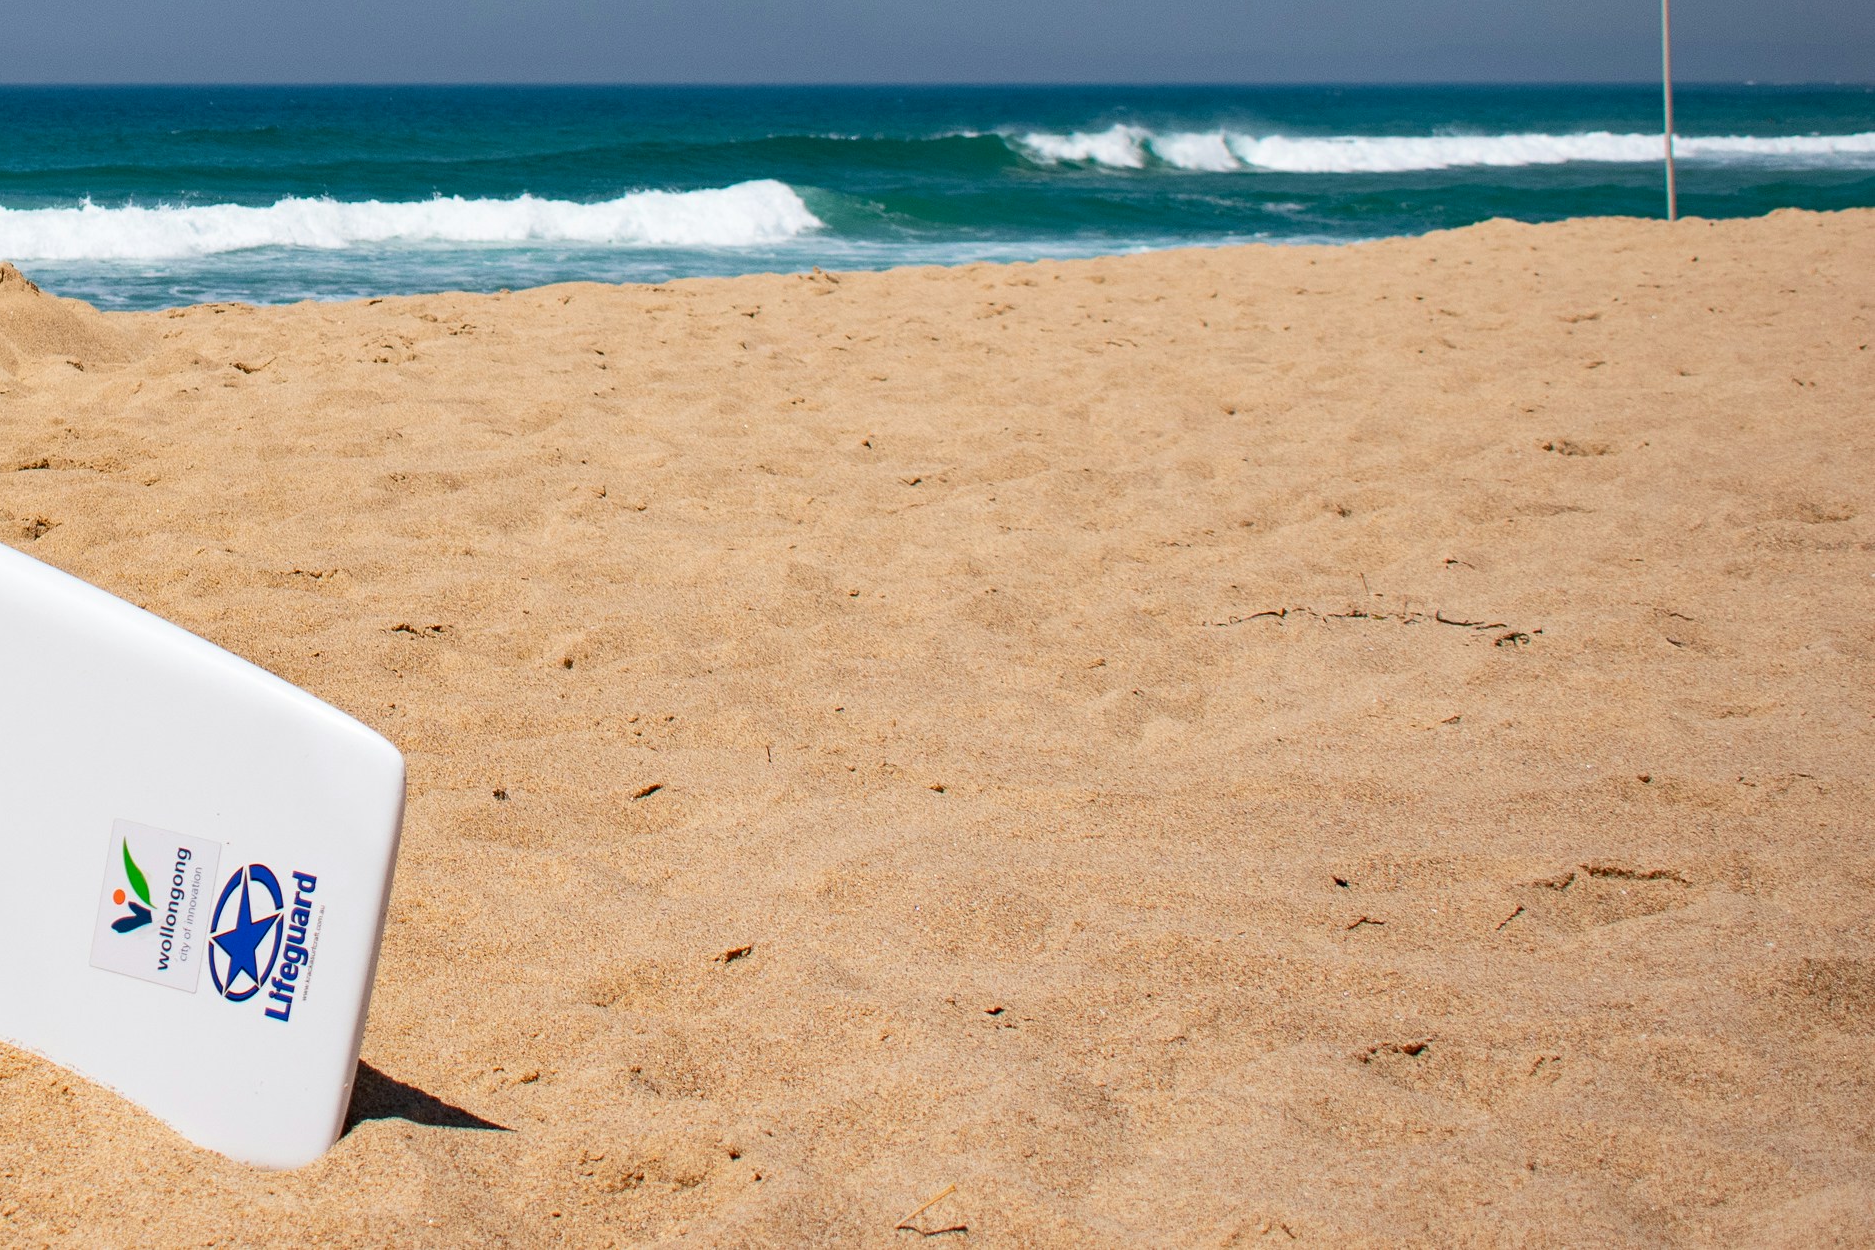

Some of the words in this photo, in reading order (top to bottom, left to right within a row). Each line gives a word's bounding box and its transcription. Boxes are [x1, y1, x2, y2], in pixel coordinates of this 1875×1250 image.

[157, 847, 192, 971] wollongong
[184, 866, 203, 925] innovation
[179, 942, 191, 962] city
[182, 927, 192, 940] of
[264, 870, 318, 1022] Lifeguard
